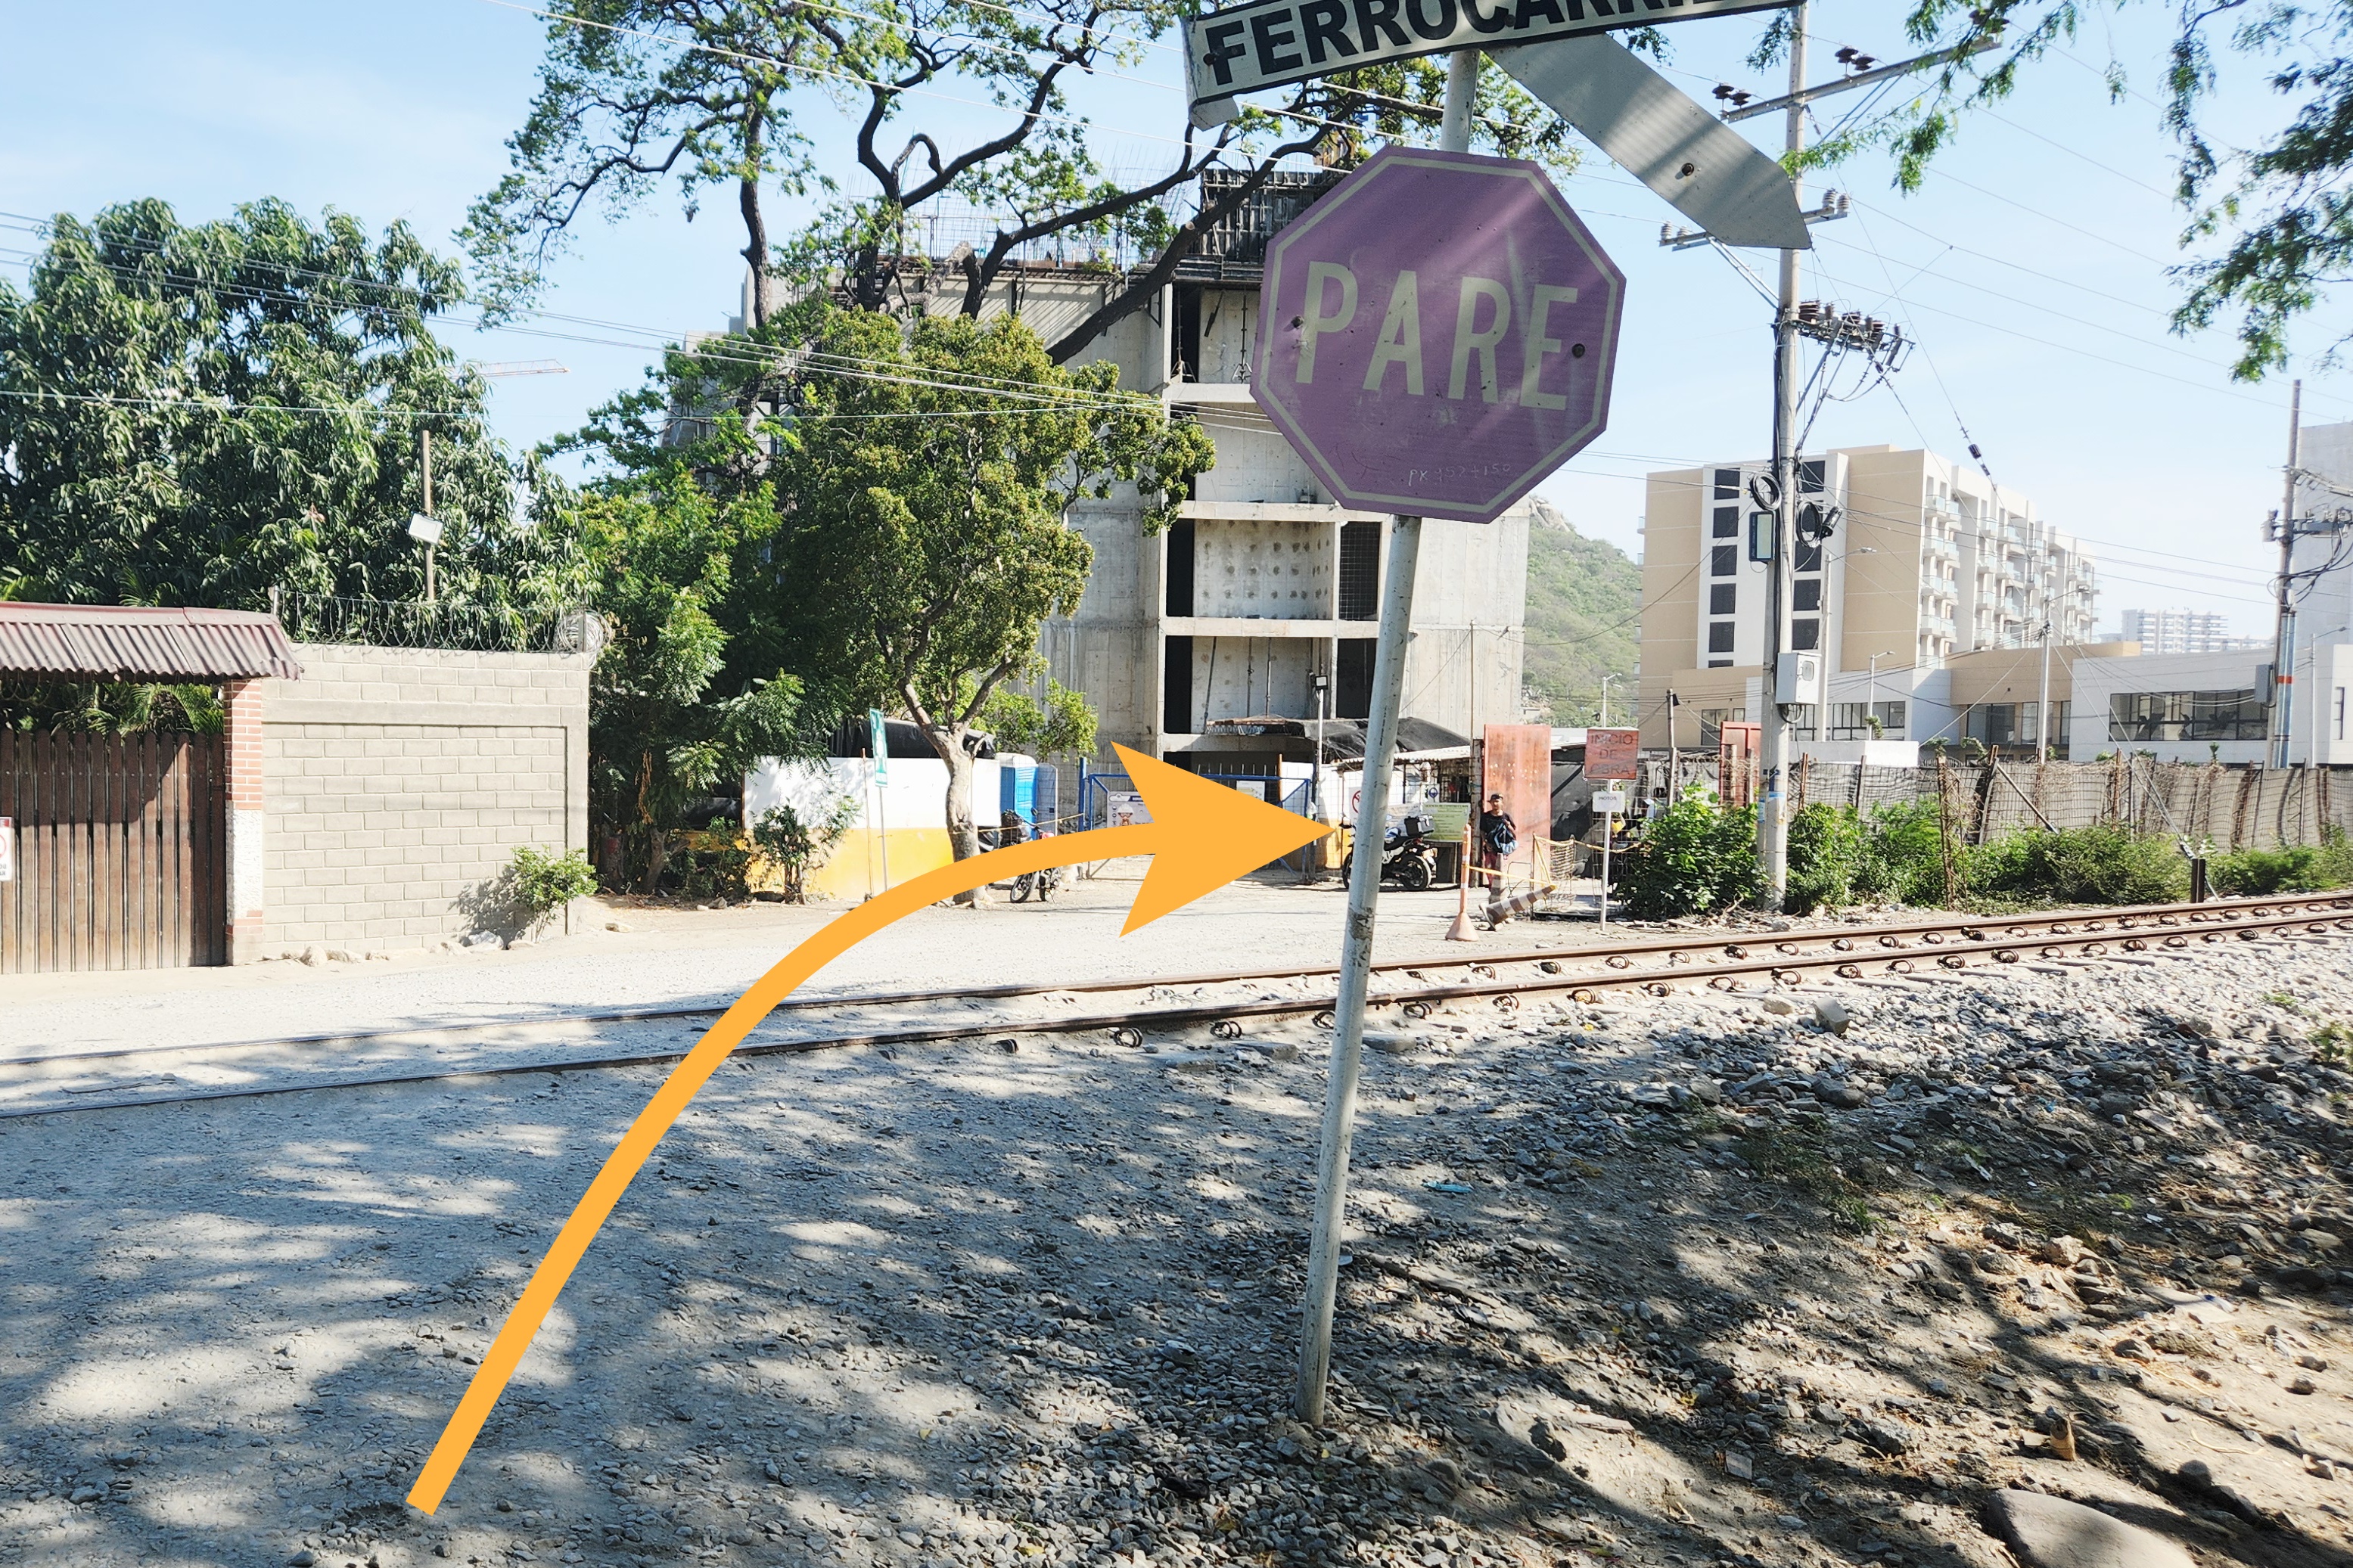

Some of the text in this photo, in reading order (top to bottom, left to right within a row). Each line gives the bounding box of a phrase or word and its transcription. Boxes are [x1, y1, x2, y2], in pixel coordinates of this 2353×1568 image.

[1205, 0, 1722, 85] FERROCA
[1296, 261, 1578, 411] PARE
[1599, 749, 1617, 759] DE
